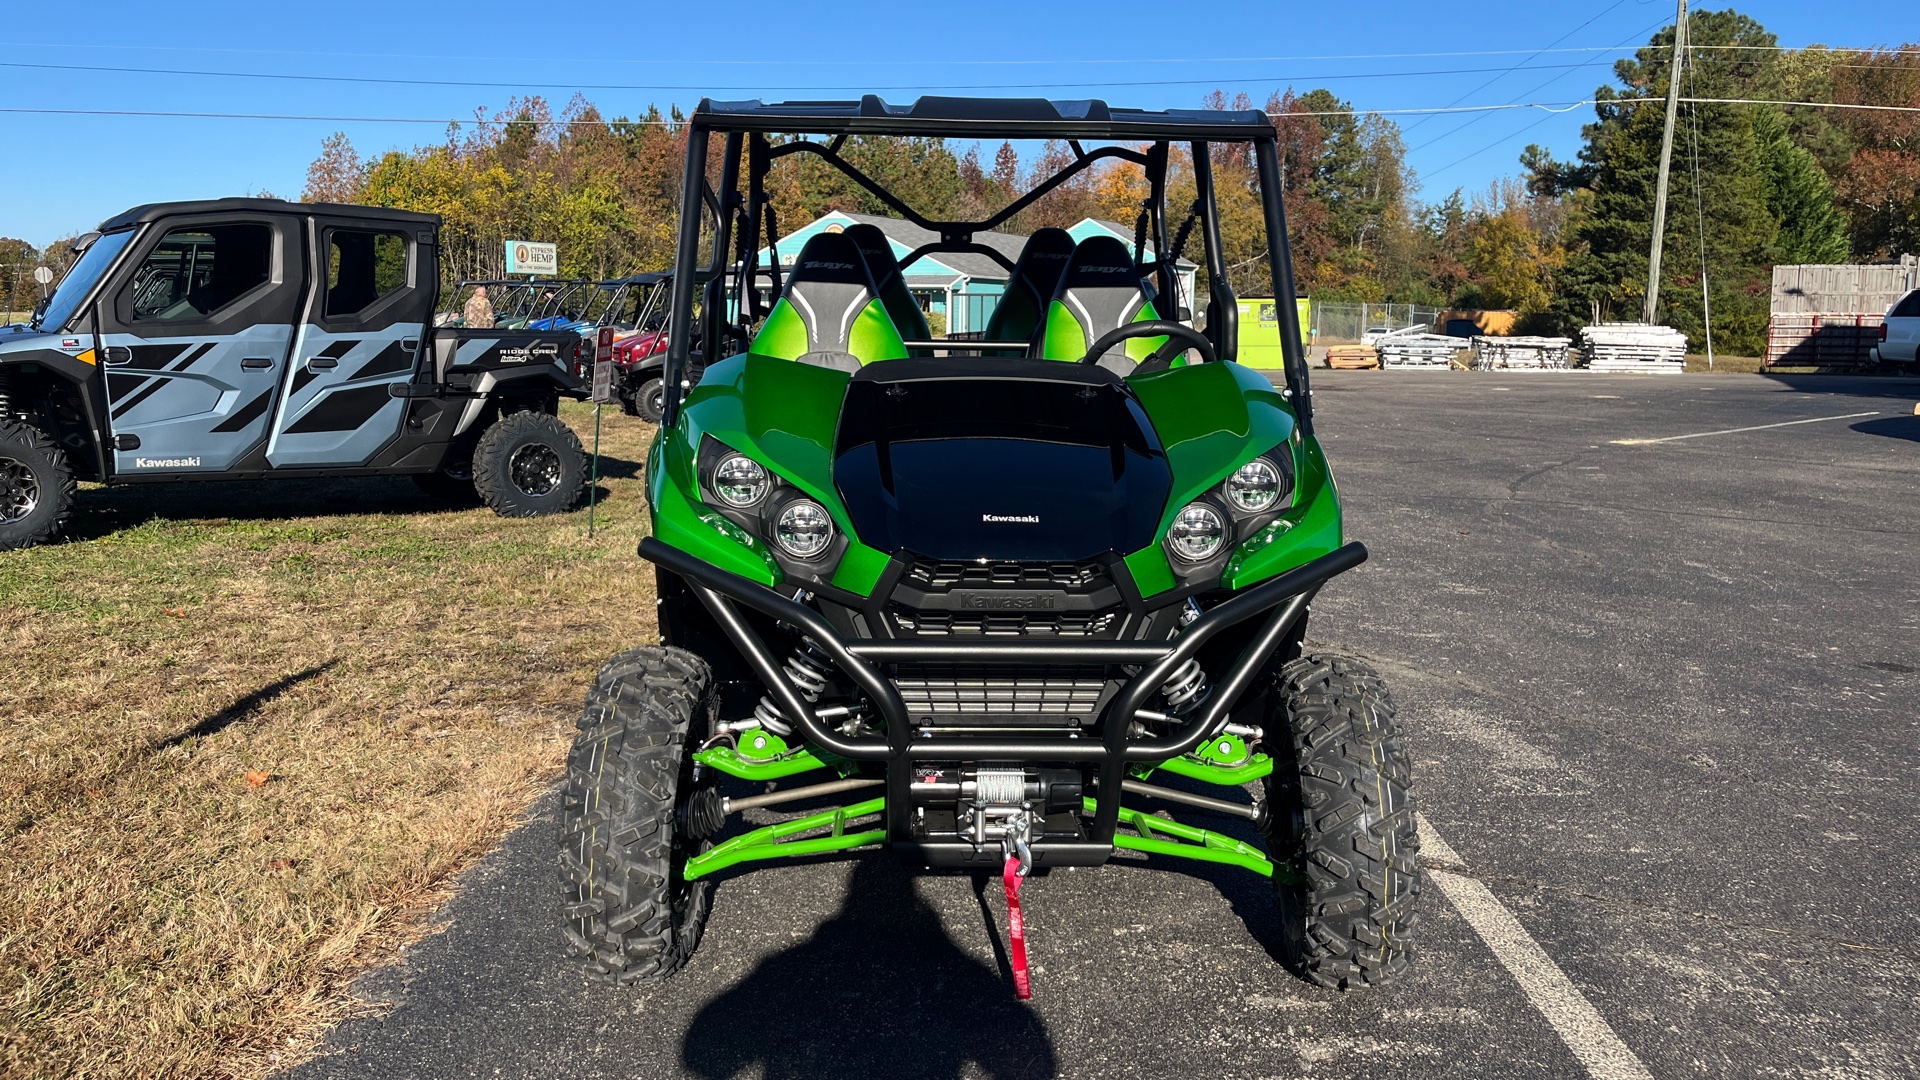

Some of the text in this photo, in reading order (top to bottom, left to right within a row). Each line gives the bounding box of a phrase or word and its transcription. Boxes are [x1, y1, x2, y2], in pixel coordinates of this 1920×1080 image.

[530, 246, 554, 254] CYPRESS
[530, 253, 554, 263] HEMP
[135, 456, 201, 468] Kawasaki
[982, 514, 1040, 523] Kawasaki
[960, 593, 1055, 609] Kawasaki
[1015, 969, 1029, 996] WARN
